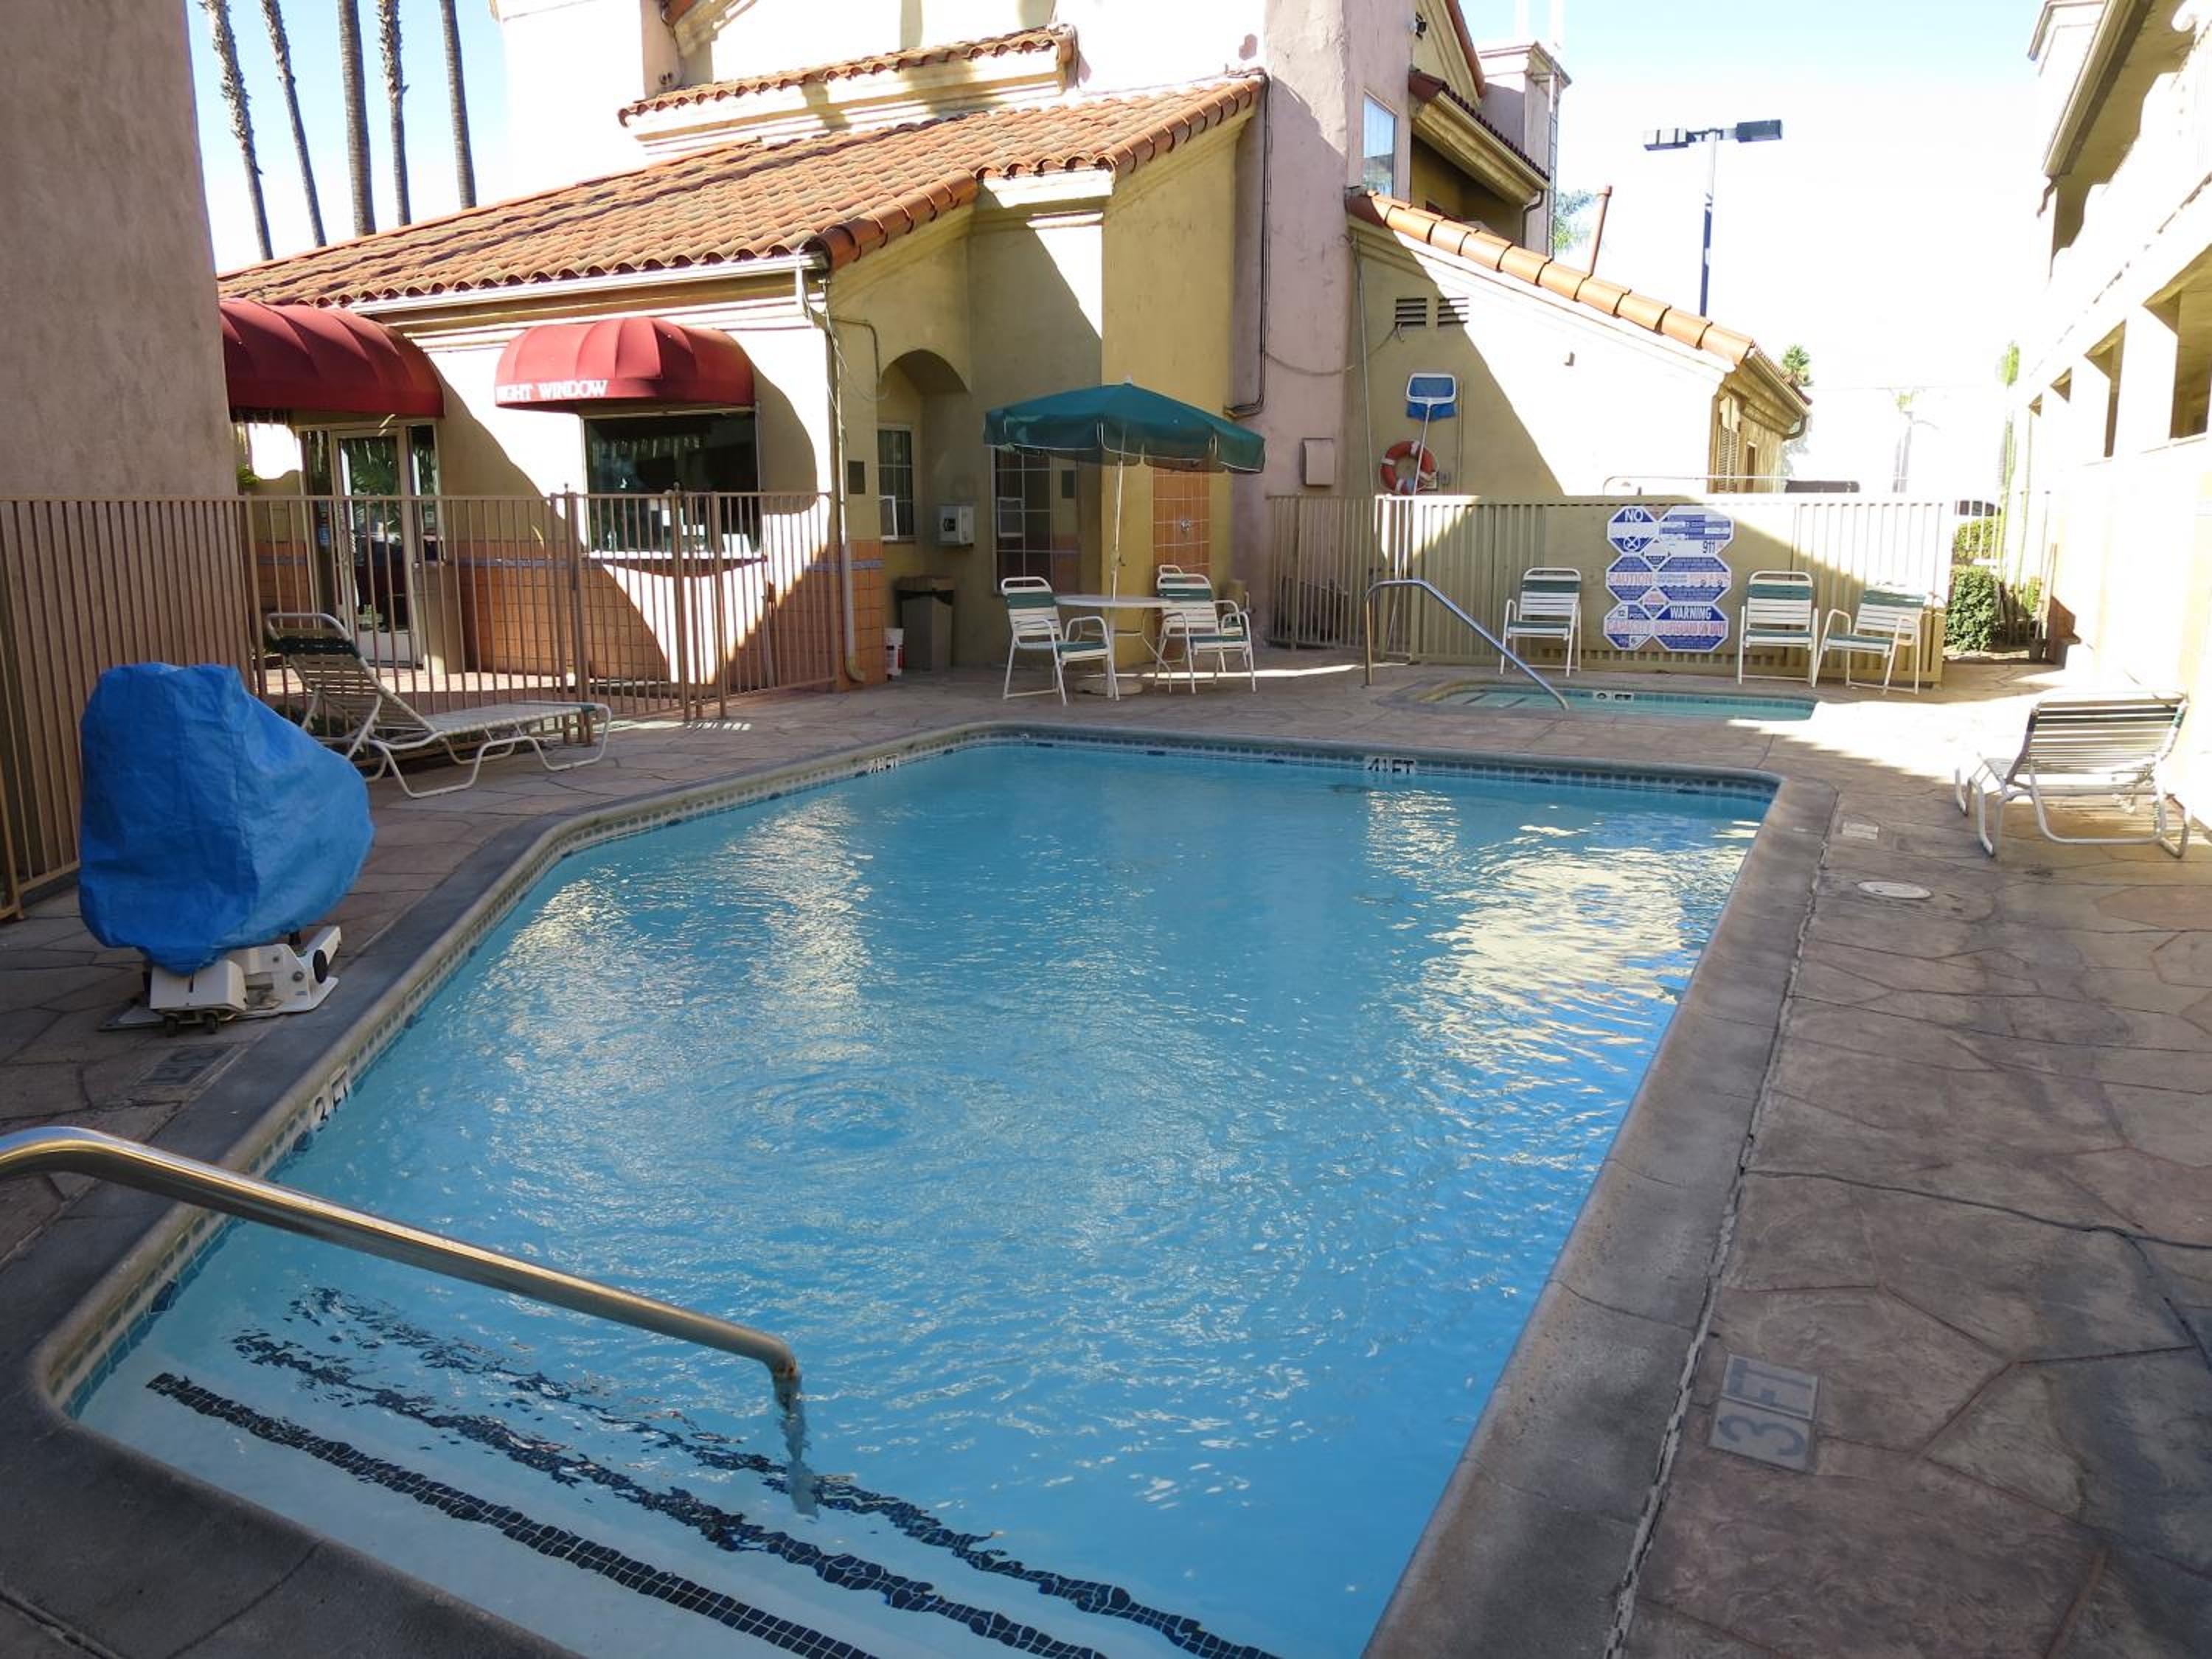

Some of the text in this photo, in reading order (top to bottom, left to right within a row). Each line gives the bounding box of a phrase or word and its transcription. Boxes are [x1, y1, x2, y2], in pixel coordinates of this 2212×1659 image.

[538, 380, 608, 399] WINDOW
[1624, 509, 1644, 522] NO
[1703, 540, 1716, 554] 911
[1609, 573, 1652, 585] CAUTION
[1669, 606, 1711, 620] WARNING
